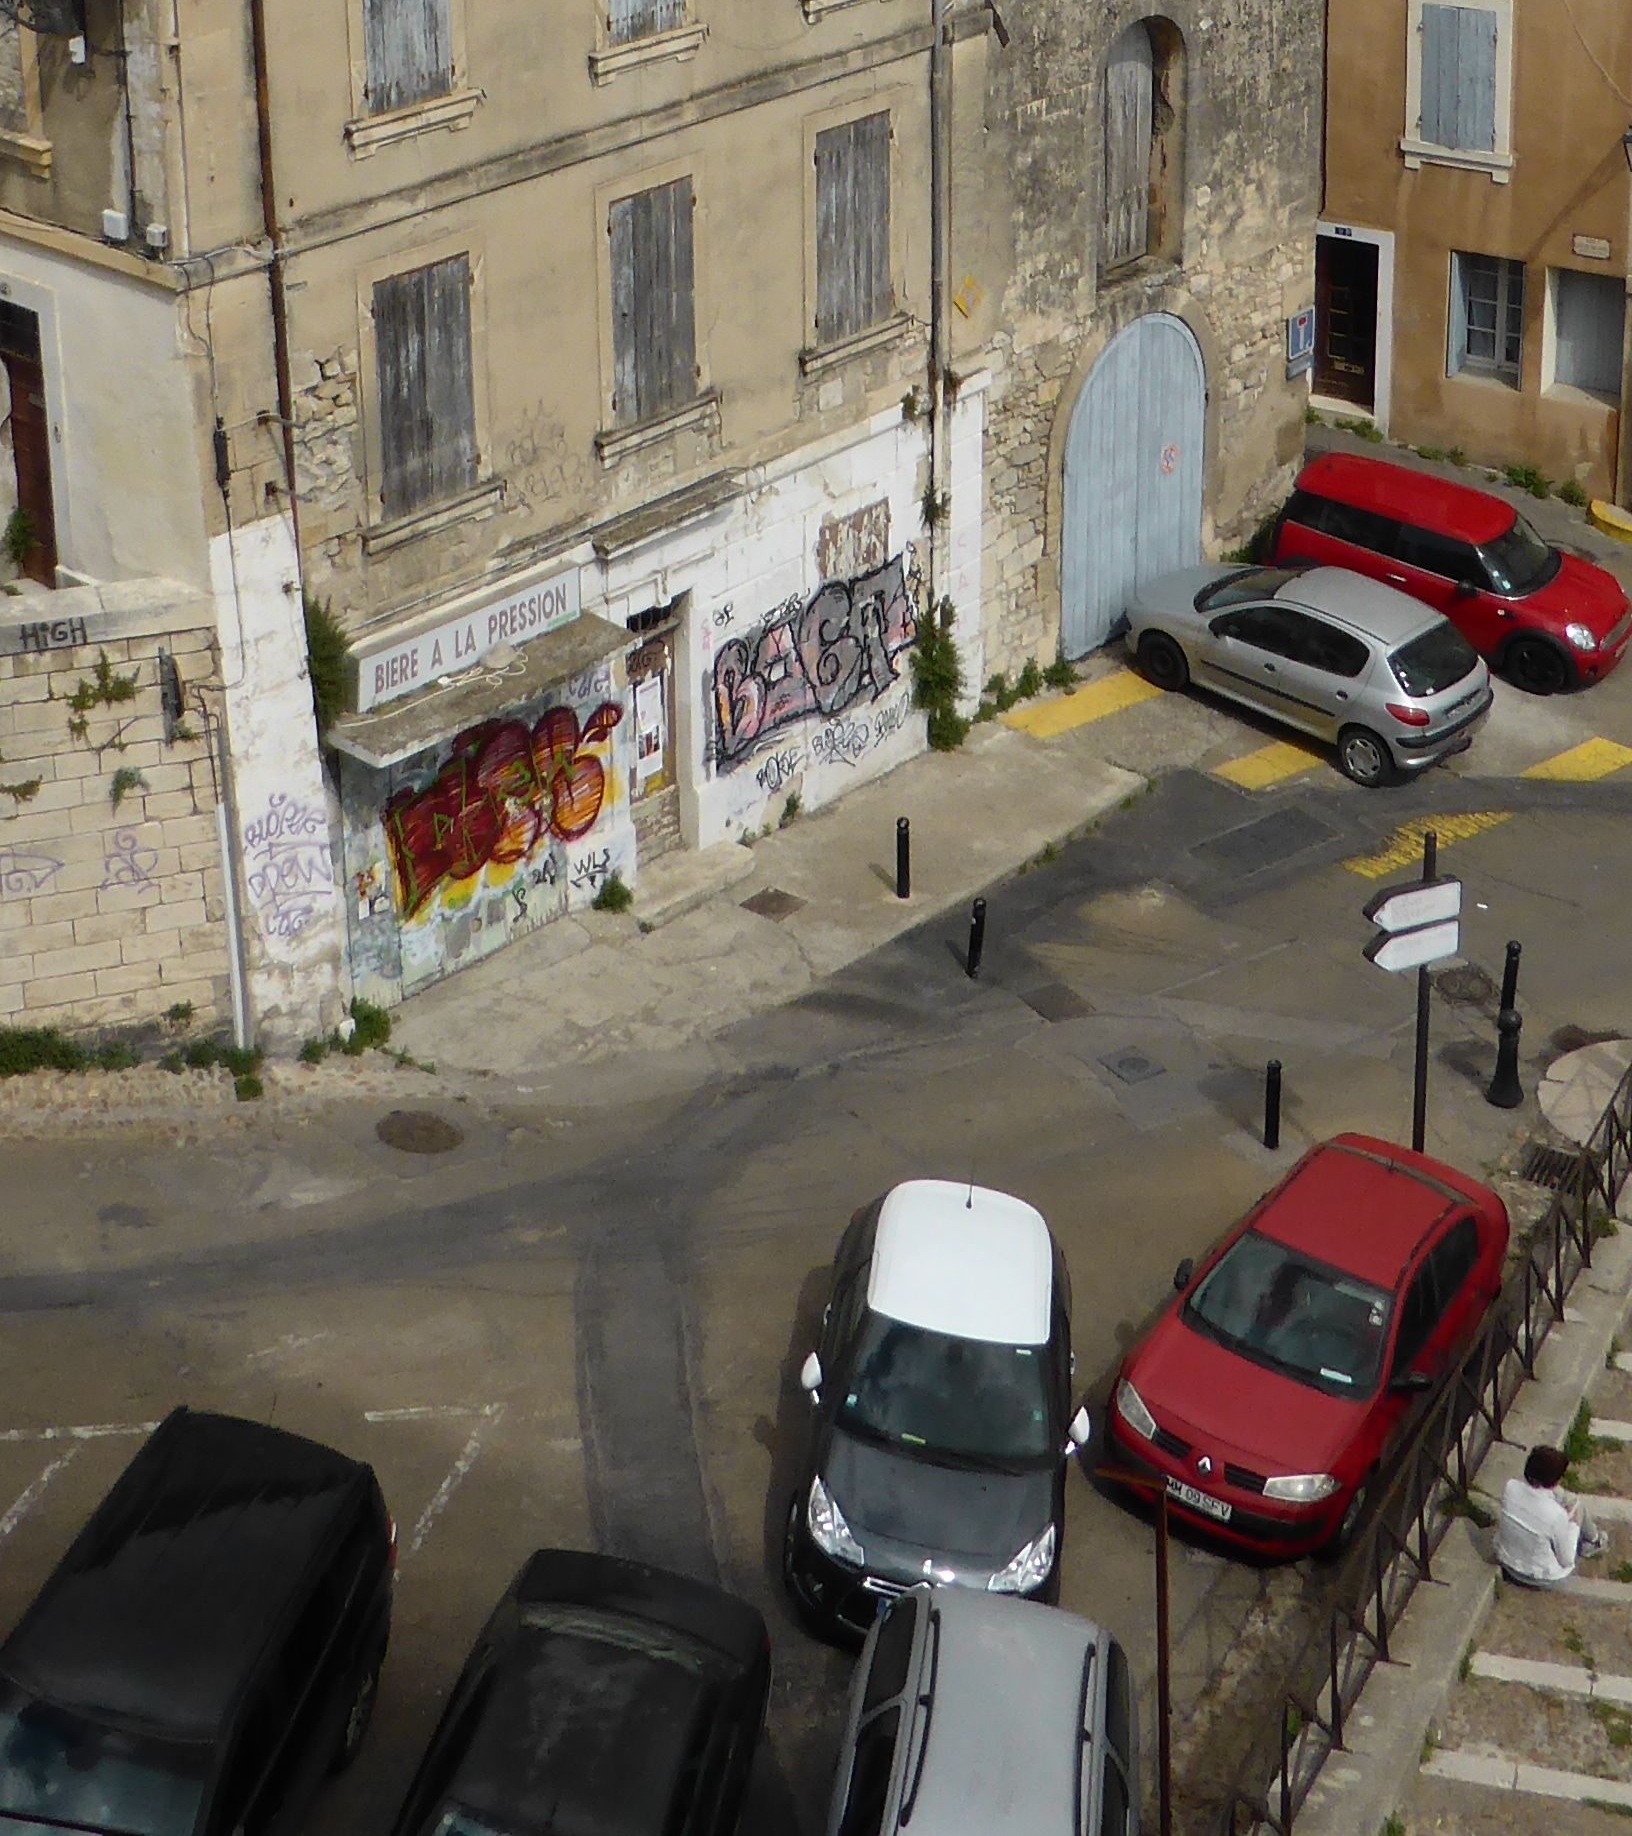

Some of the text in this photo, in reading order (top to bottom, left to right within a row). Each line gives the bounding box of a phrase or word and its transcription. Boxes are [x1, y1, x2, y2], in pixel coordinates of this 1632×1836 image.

[375, 582, 568, 694] BIERE A LA PRESSION
